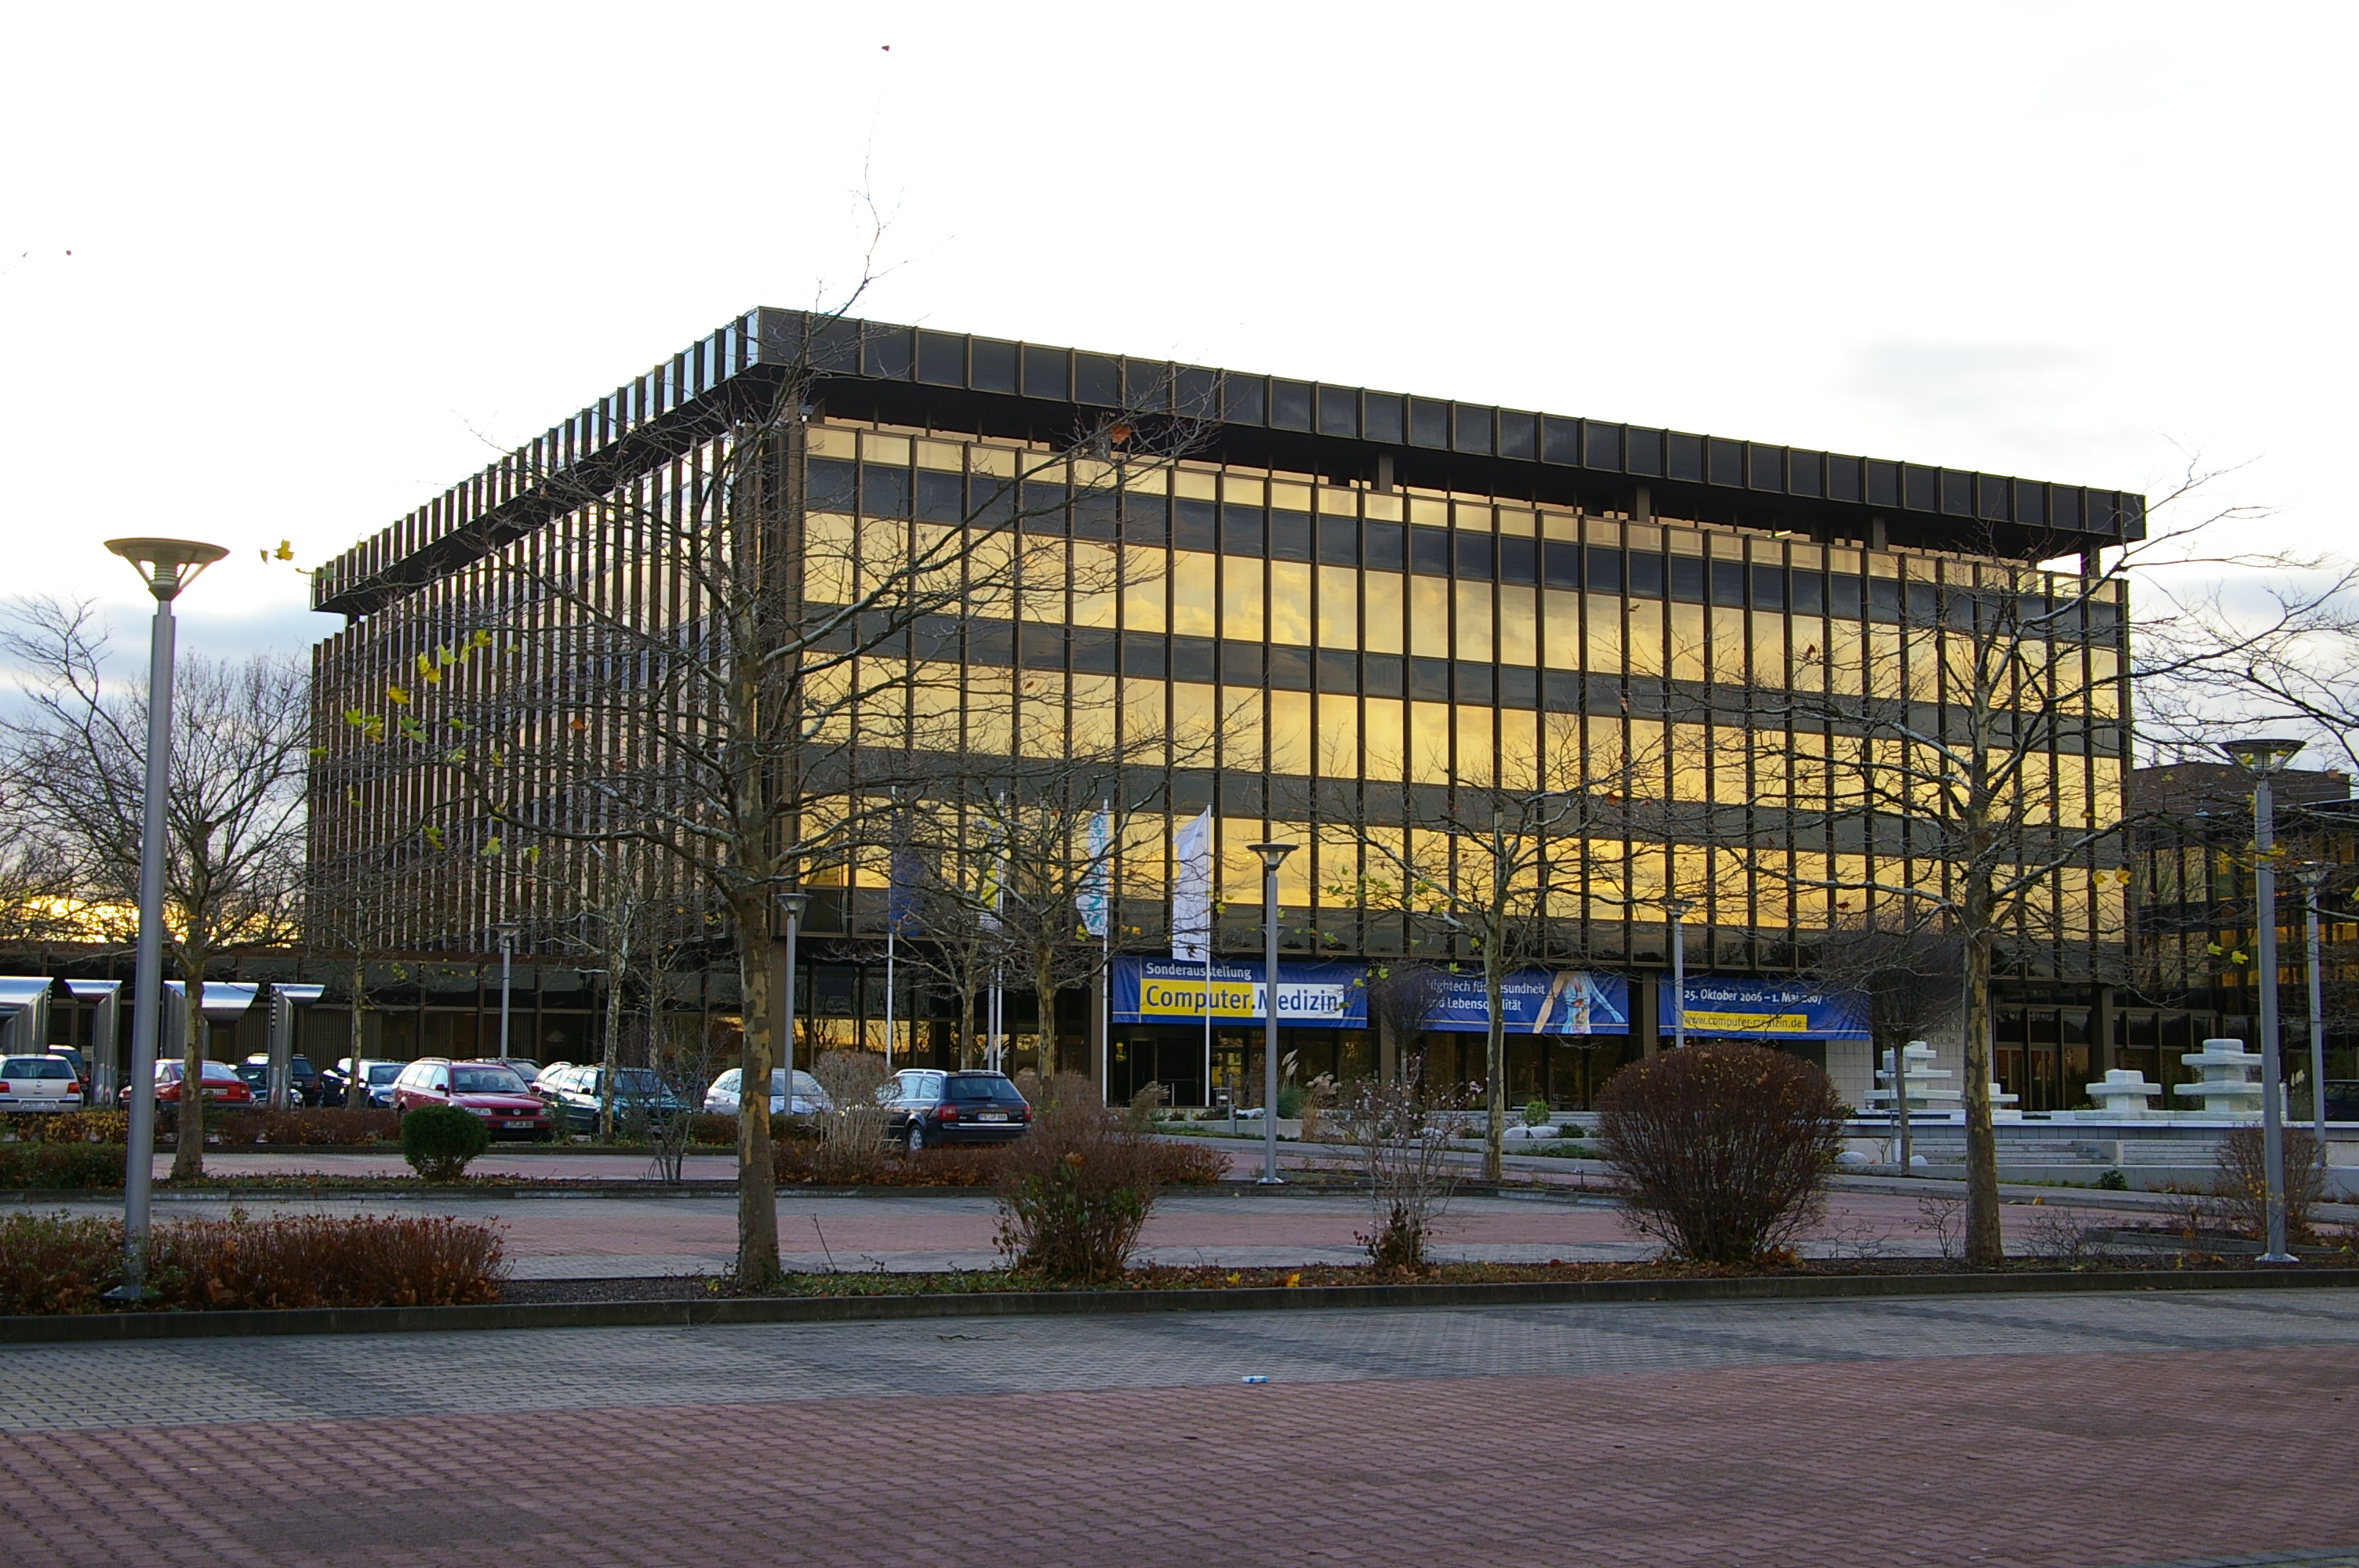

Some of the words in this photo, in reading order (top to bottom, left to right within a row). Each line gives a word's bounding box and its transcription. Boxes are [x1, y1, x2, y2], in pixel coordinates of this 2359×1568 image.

[1146, 962, 1252, 981] Sonderausstellung
[1427, 978, 1471, 994] Hightech
[1499, 982, 1546, 995] esundheit
[1428, 995, 1445, 1009] nd
[1448, 996, 1521, 1012] Lebensqlität
[1684, 989, 1699, 1002] 25.
[1700, 988, 1738, 1002] Oktober
[1740, 991, 1763, 1003] 2006
[1772, 993, 1780, 1004] 1.
[1781, 991, 1800, 1004] Mai
[1801, 994, 1823, 1006] 2007
